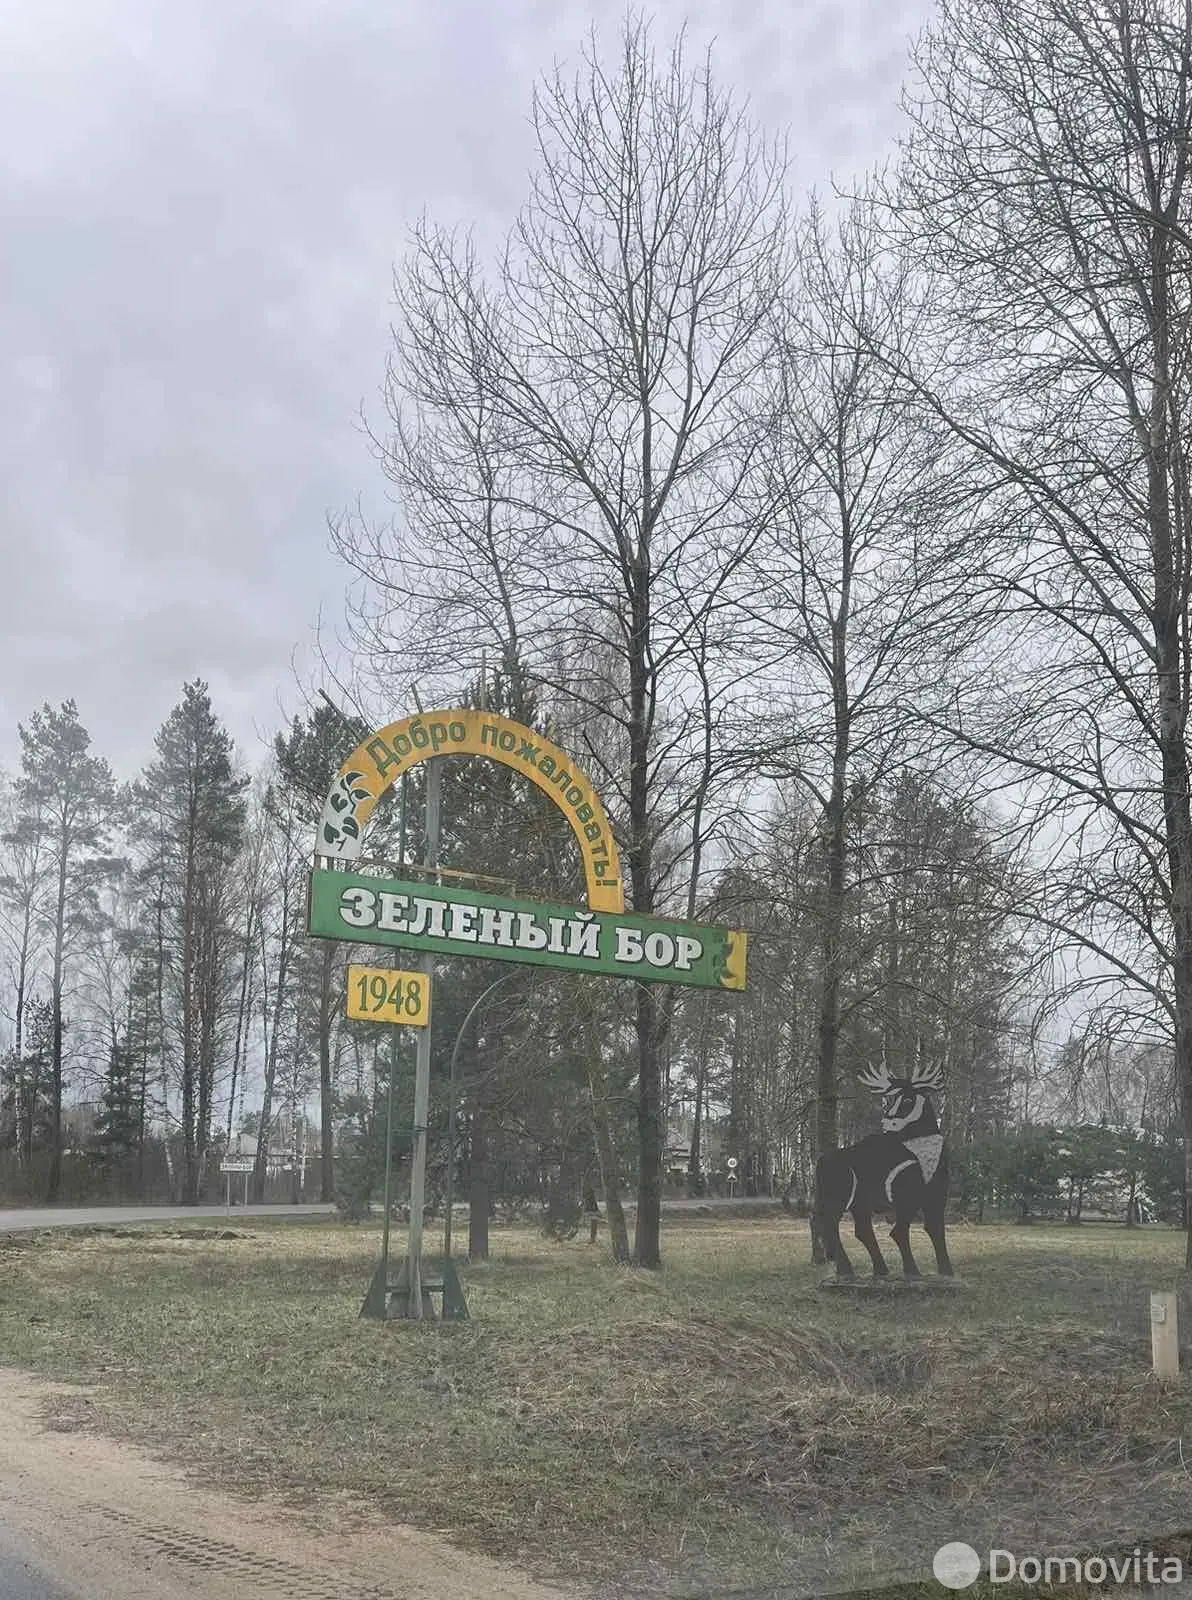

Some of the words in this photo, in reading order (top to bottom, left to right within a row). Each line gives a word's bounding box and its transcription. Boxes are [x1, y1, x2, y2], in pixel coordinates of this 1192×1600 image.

[367, 719, 467, 778] Добро
[481, 721, 618, 888] пожаловать!
[338, 887, 602, 959] ЗЕЛЕНЫЙ
[614, 926, 704, 970] БОР
[356, 974, 422, 1017] 1948
